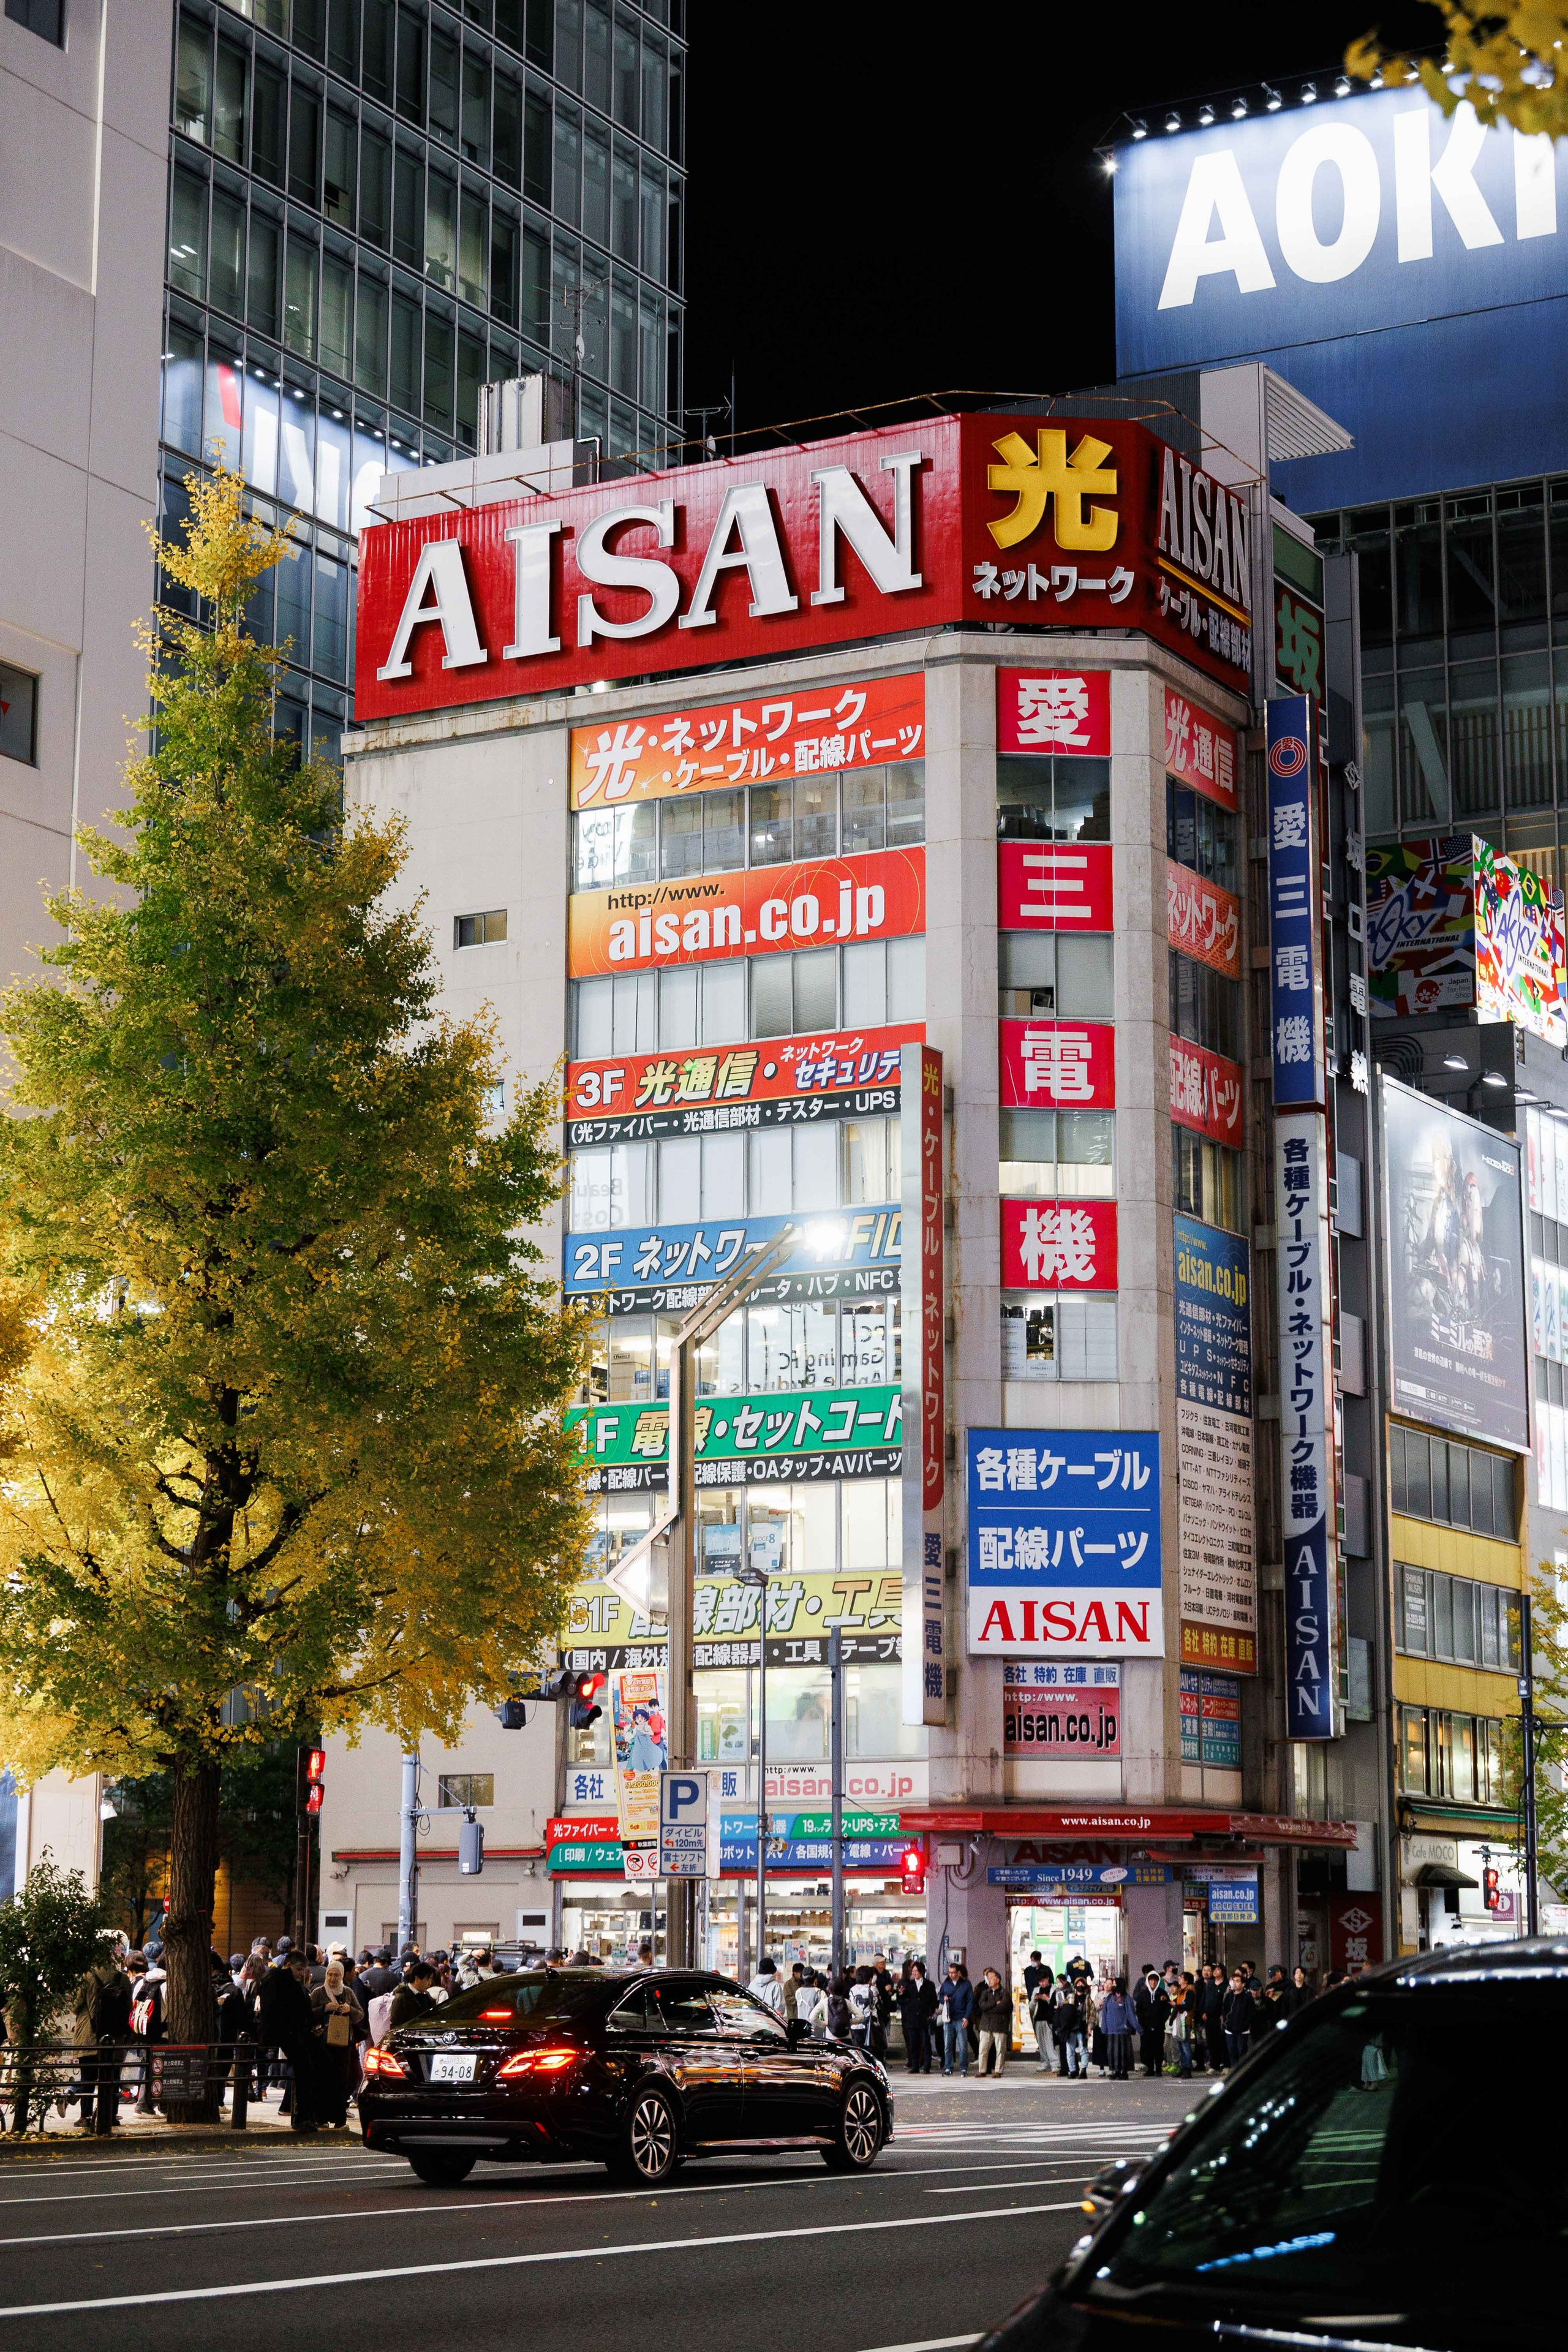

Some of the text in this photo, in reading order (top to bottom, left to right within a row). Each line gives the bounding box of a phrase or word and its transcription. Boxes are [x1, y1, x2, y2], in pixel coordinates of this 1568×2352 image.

[1158, 100, 1556, 310] AOKI
[987, 429, 1118, 550] 光
[1159, 447, 1251, 611] AISAN
[377, 450, 922, 681] AISAN
[972, 562, 1134, 604] ネットワーク
[1160, 576, 1251, 673] ケーブル・配線部材
[579, 724, 646, 806] 光
[1165, 698, 1234, 793] 光通信
[608, 883, 725, 910] http://www.
[1167, 872, 1238, 961] ネットワーク
[608, 880, 885, 962] aisan.co.jp
[1273, 802, 1311, 1065] 愛三電機
[1396, 934, 1460, 948] INTERNATIONAL
[1017, 677, 1096, 1281] 愛 三 電 機
[1518, 954, 1548, 978] INTERNATIONAL
[780, 1037, 864, 1063] ネットワーク
[576, 1069, 625, 1108] 3F
[795, 1050, 901, 1090] セキュリテ
[1170, 1048, 1240, 1129] 配線パーツ
[573, 1243, 624, 1280] 2F
[924, 1063, 940, 1487] 光・ケーブル・ネットワーク
[1178, 1248, 1247, 1307] aisan.co.jp
[1283, 1138, 1318, 1519] 各種ケーブル・ネットワーク機器
[976, 1447, 1150, 1491] 各種ケーブル
[978, 1527, 1149, 1570] 配線パーツ
[568, 1596, 620, 1633] B1F
[924, 1532, 943, 1698] 愛三電機
[978, 1601, 1150, 1642] AISAN
[1292, 1545, 1321, 1716] AISAN
[1185, 1628, 1253, 1662] 各社 特約 在庫 直販
[1005, 1667, 1117, 1684] 各社 特約 在庫 直販
[1005, 1692, 1078, 1704] http://www.
[1005, 1706, 1117, 1747] aisan.co.jp
[575, 1774, 604, 1800] 各社
[669, 1779, 699, 1819] P
[766, 1773, 913, 1798] aisanco.jp
[665, 1828, 703, 1838] ダイビル
[675, 1839, 703, 1847] 120m先
[1061, 1815, 1152, 1830] www.aisan.co.jp
[664, 1853, 703, 1863] 富士ソフト
[681, 1864, 697, 1872] 左折
[1013, 1840, 1120, 1864] AISAN
[1412, 1845, 1454, 1861] Cafe MOCO
[1037, 1874, 1060, 1883] Since
[1060, 1869, 1093, 1882] 1949
[1212, 1888, 1254, 1901] aisan.co.jp
[440, 2066, 472, 2078] 94-08
